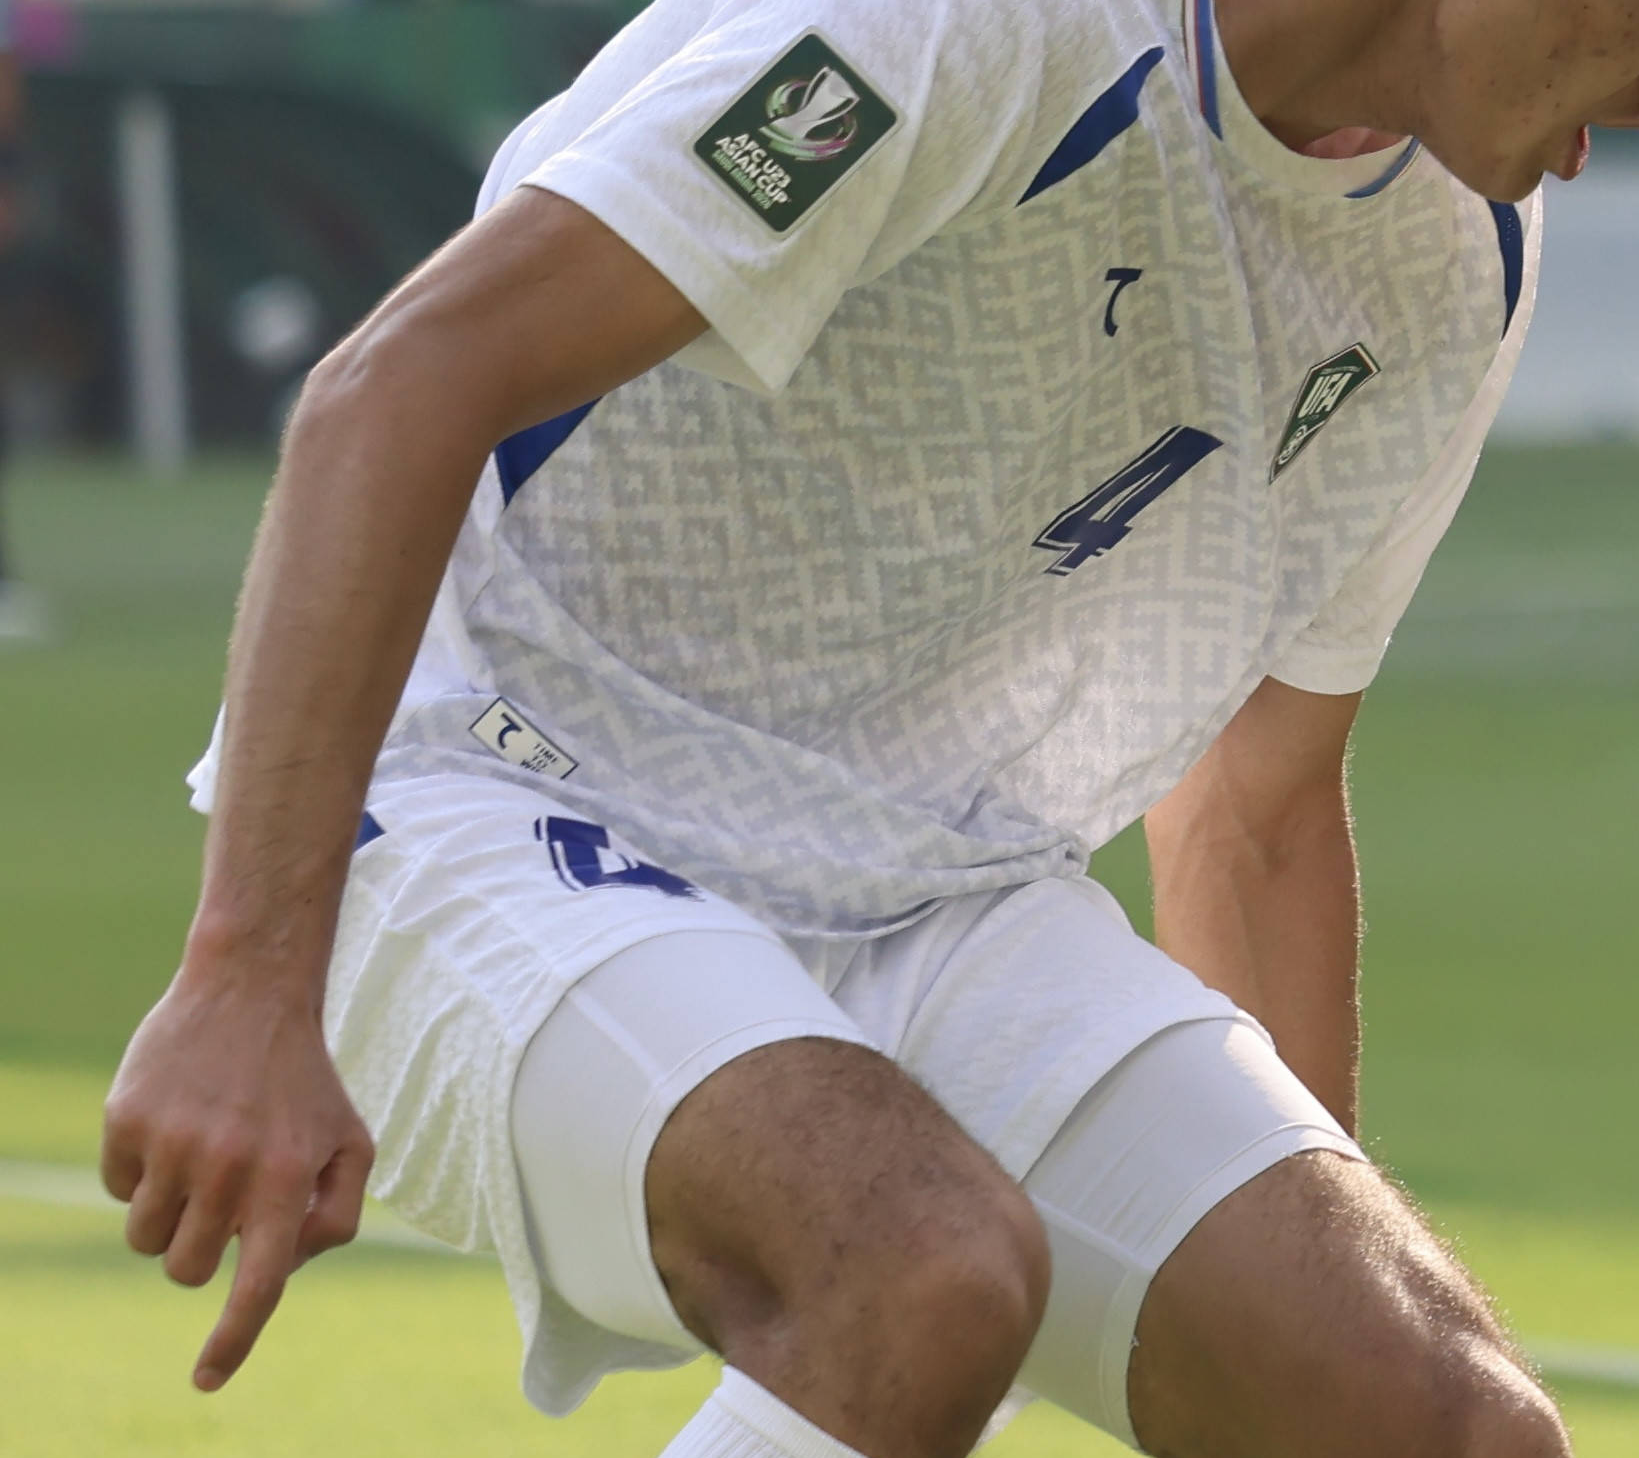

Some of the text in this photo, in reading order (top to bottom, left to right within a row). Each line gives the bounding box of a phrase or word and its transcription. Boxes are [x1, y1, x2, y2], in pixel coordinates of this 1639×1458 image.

[715, 136, 788, 204] ASIAN CUP
[732, 133, 792, 188] AFC U23
[1297, 372, 1353, 419] UFA
[1031, 424, 1224, 577] 4
